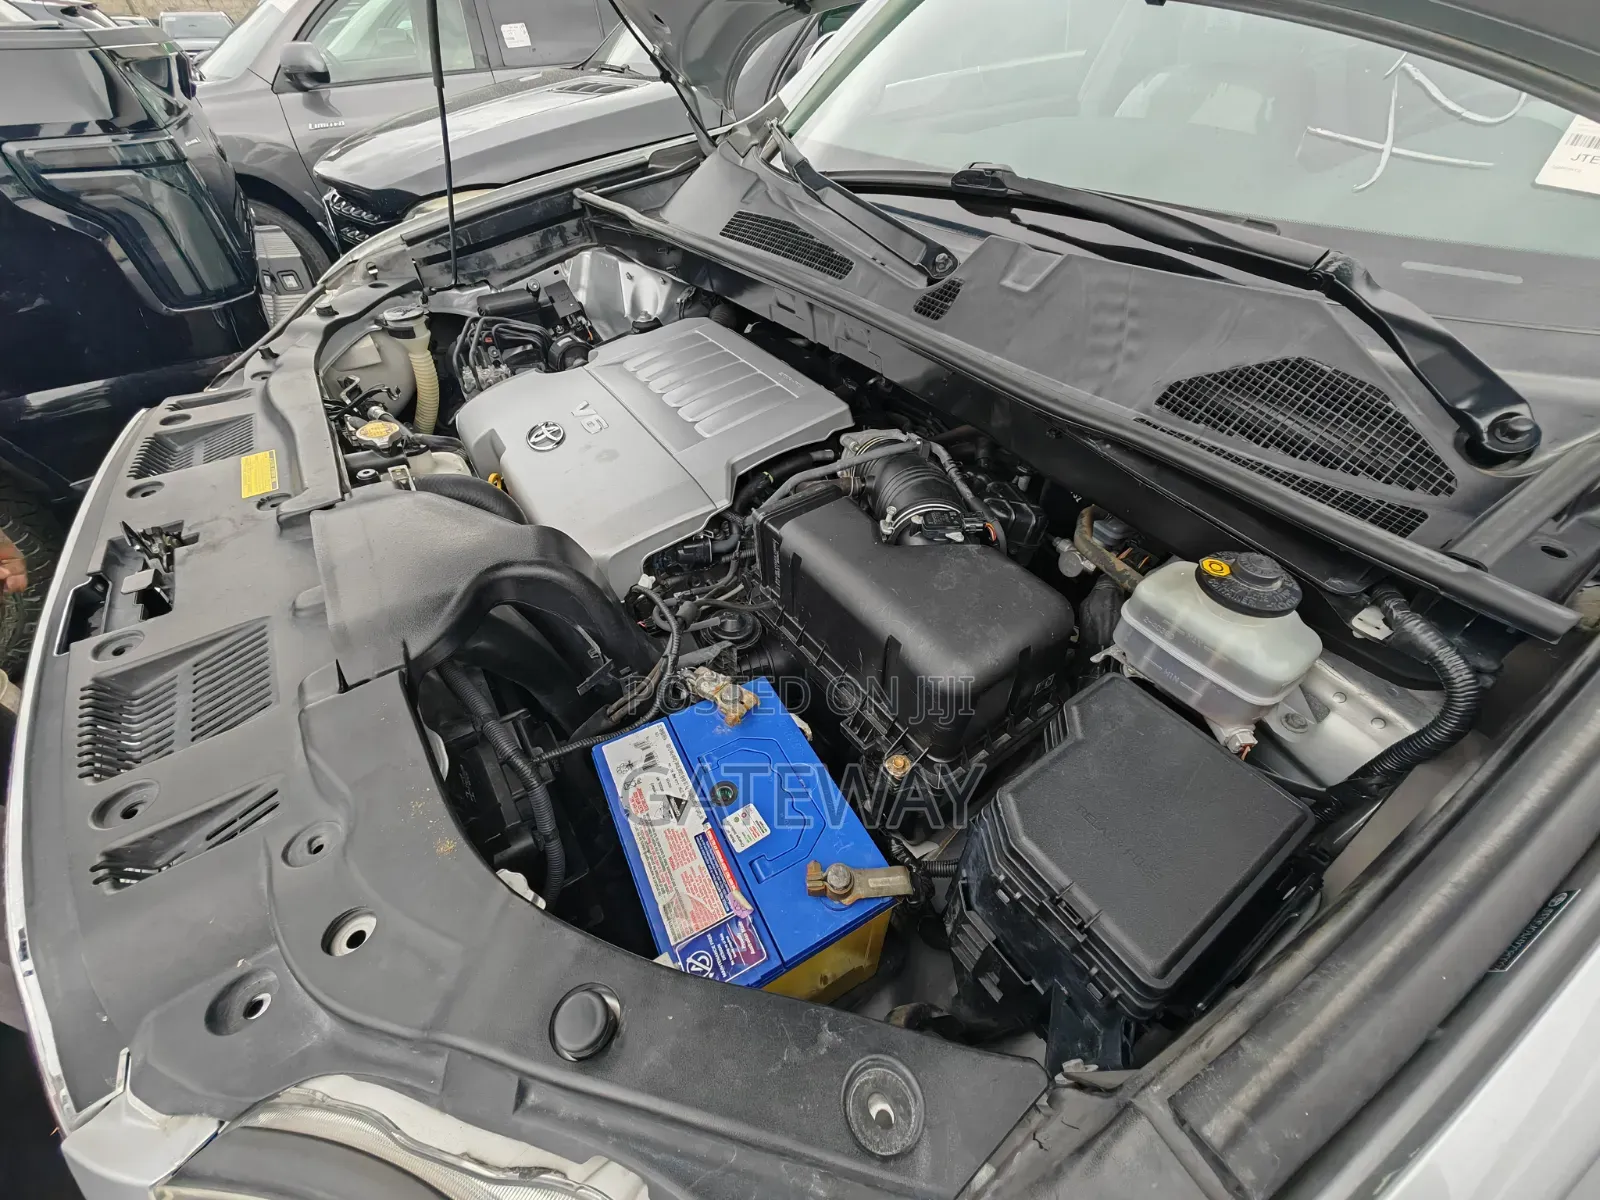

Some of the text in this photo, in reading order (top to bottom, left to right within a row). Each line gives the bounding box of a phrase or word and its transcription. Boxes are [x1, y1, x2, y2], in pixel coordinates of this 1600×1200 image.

[570, 400, 609, 435] V6
[1163, 668, 1180, 684] MIN
[706, 933, 727, 977] MAINTENANCE FREE
